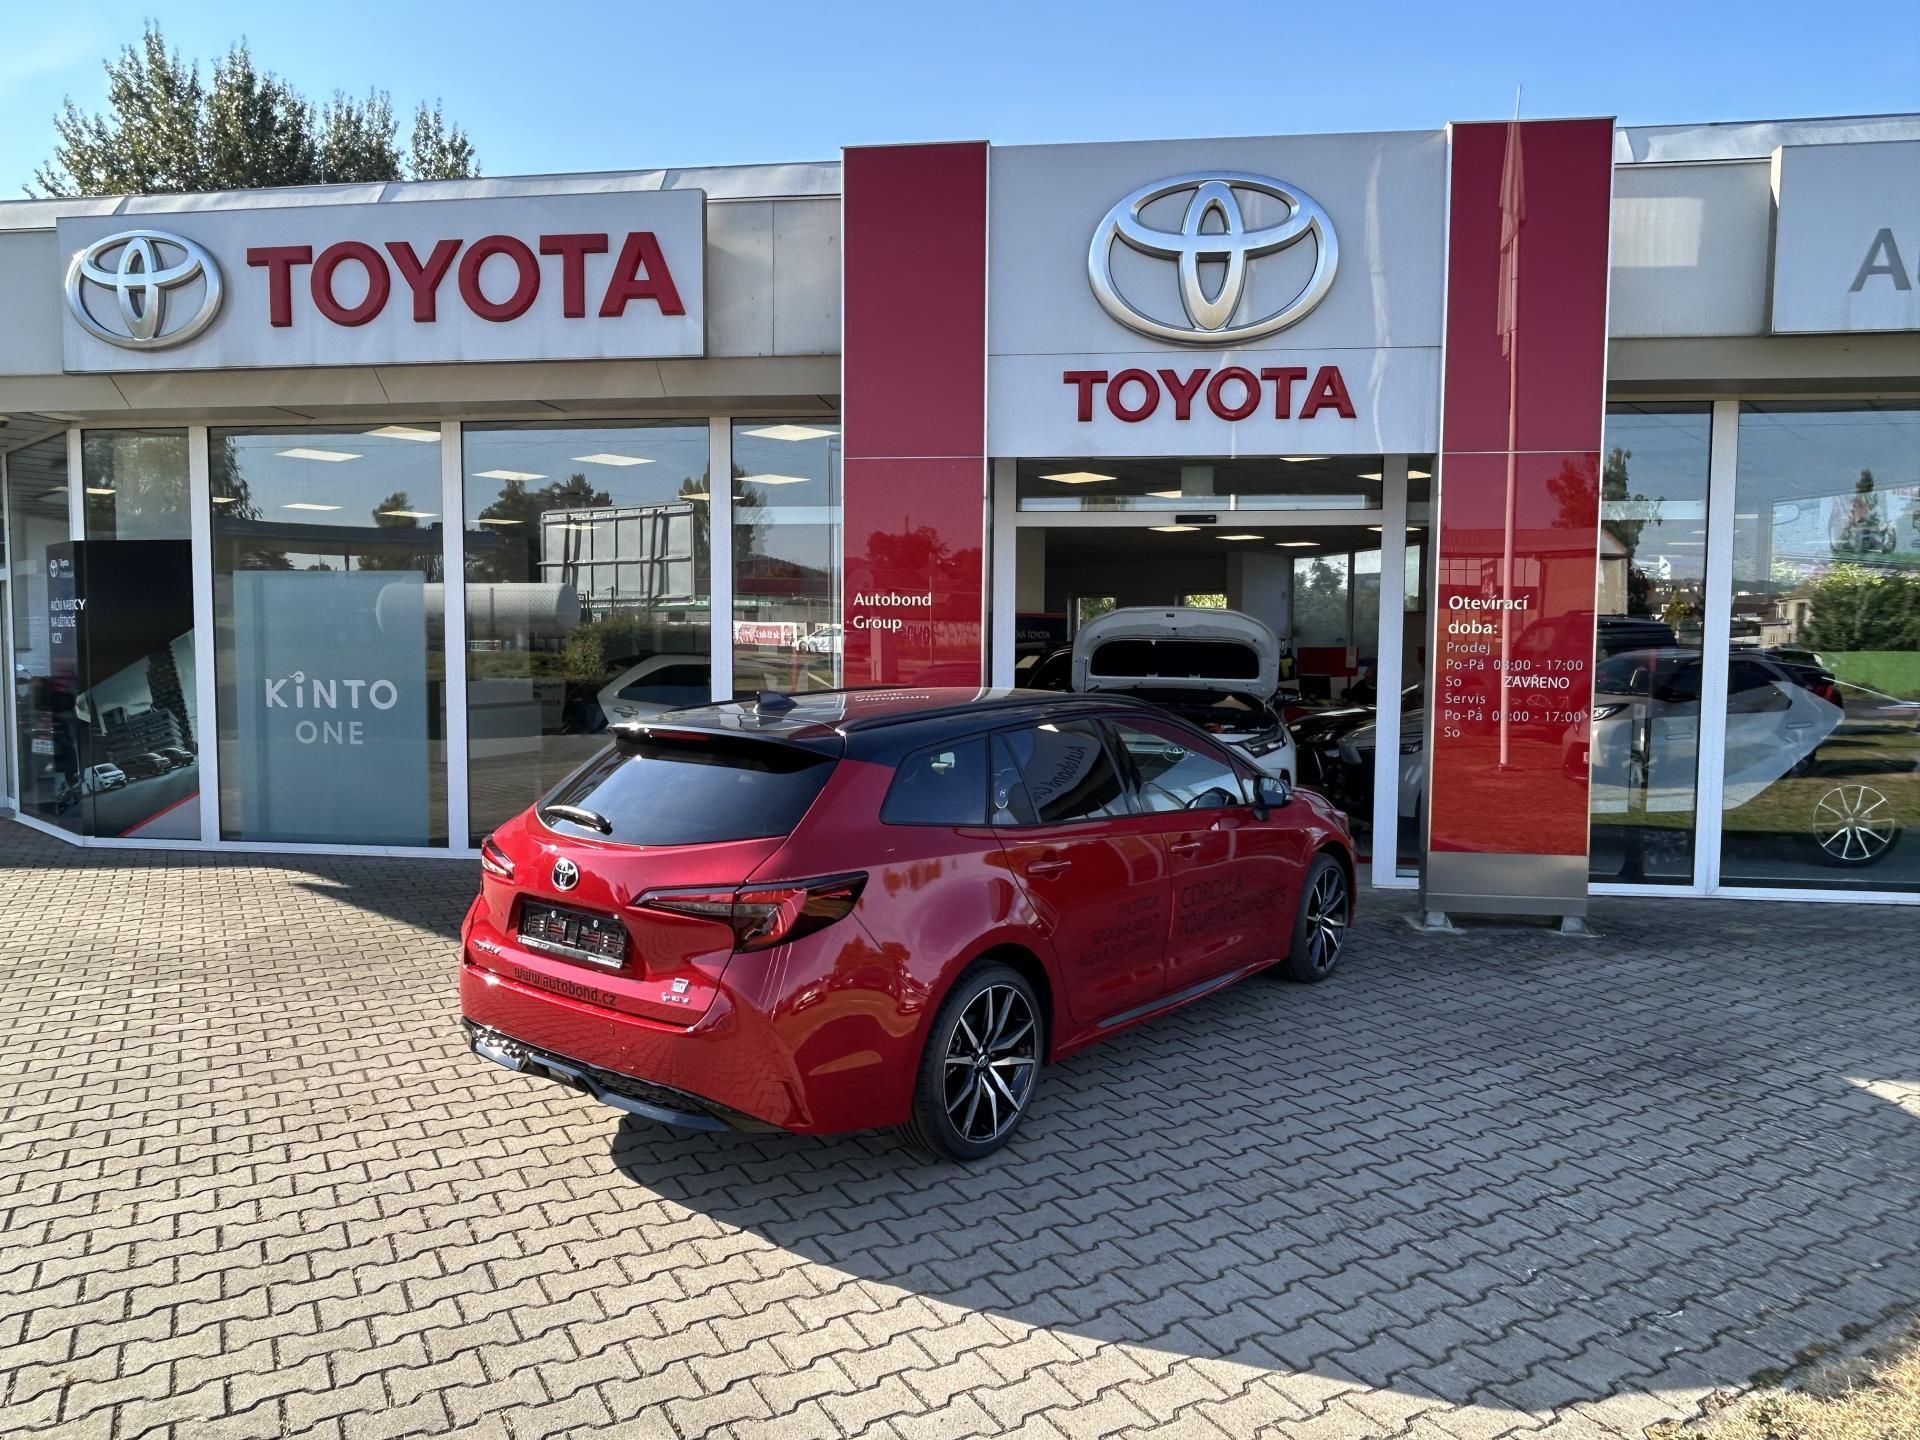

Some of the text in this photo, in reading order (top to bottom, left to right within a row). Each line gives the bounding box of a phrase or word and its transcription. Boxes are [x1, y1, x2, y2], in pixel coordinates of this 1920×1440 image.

[1848, 227, 1920, 293] A
[246, 231, 686, 328] TOYOTA
[1063, 365, 1357, 423] TOYOTA
[853, 592, 932, 607] Autobond
[1448, 594, 1530, 610] Otevírací
[853, 615, 902, 632] Group
[1448, 619, 1498, 635] doba:
[1446, 641, 1490, 655] Prodej
[1446, 659, 1484, 670] Po-Pá
[1547, 660, 1584, 671] 17:00
[1445, 674, 1570, 689] So ZAVŘENO
[1445, 692, 1486, 704] Servis
[1444, 708, 1482, 721] Po-Pá
[1492, 710, 1529, 722] 0:00
[1545, 711, 1582, 722] 17:00
[295, 720, 364, 745] ONE
[1443, 726, 1461, 738] So
[514, 966, 617, 1006] www.autobond.cz
